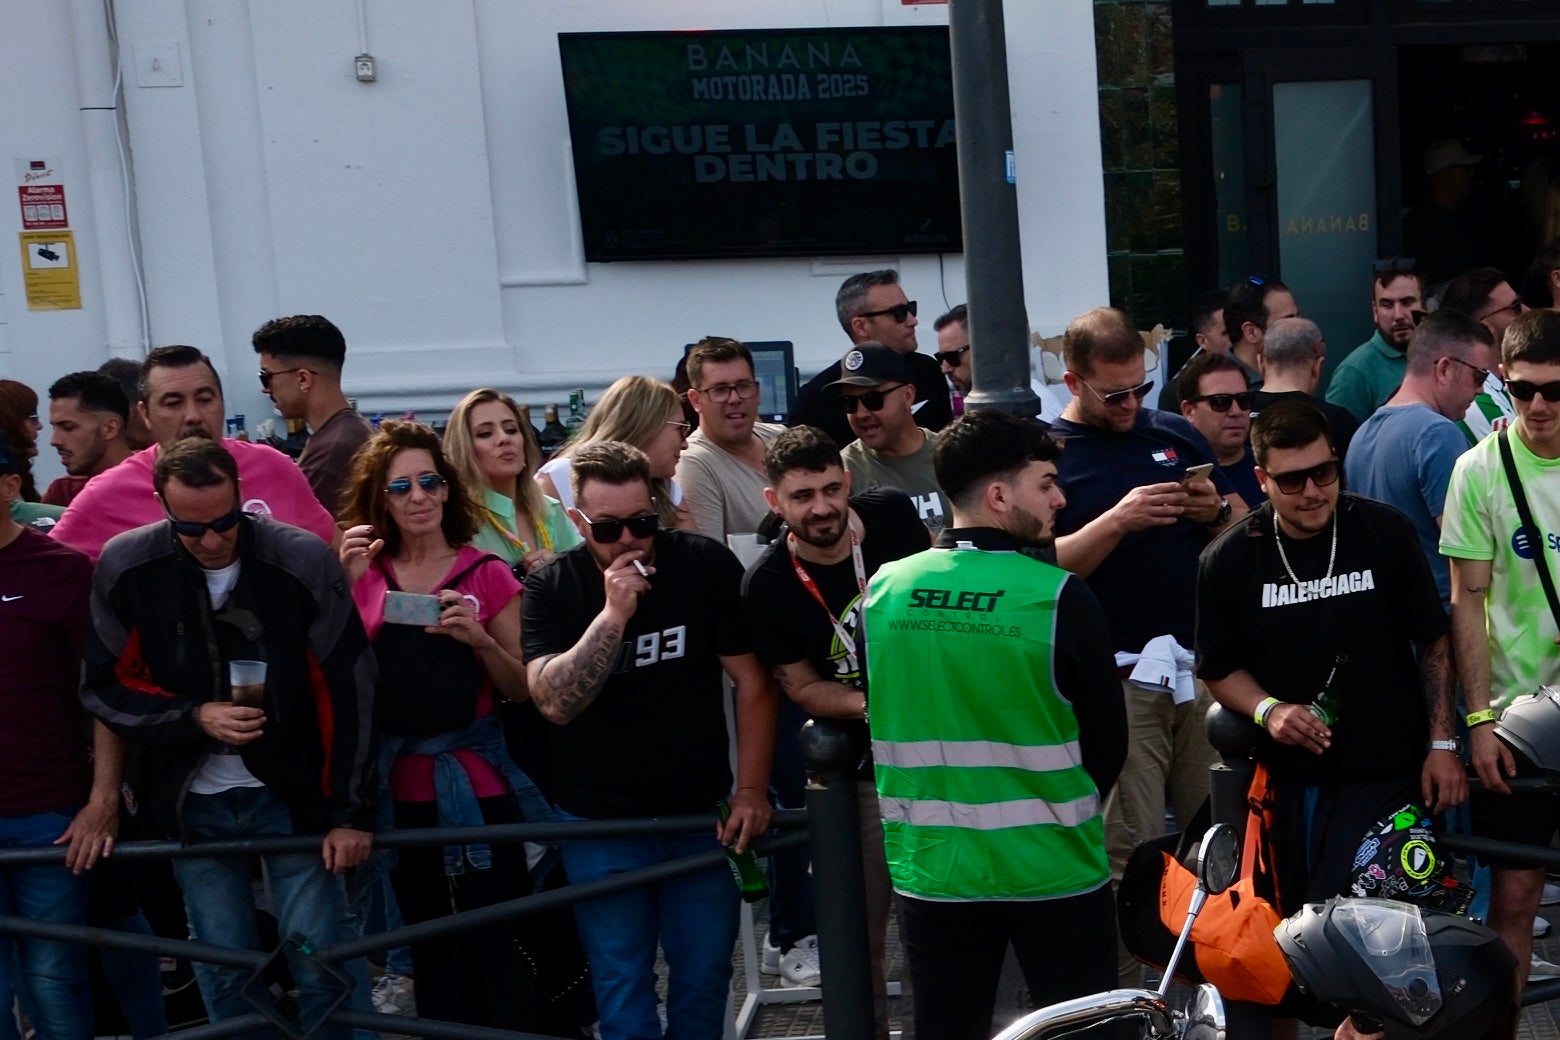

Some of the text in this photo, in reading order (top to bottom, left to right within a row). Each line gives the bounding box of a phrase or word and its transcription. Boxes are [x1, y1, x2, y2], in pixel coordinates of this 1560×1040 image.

[687, 42, 863, 71] BANANA
[692, 73, 869, 101] MOTORADA 2025
[597, 119, 957, 156] SIGUE LA FIESTA
[694, 150, 879, 183] DENTRO
[908, 588, 1005, 613] SELECT
[1261, 569, 1375, 608] BALENCIAGA
[906, 609, 1000, 622] CONTROL
